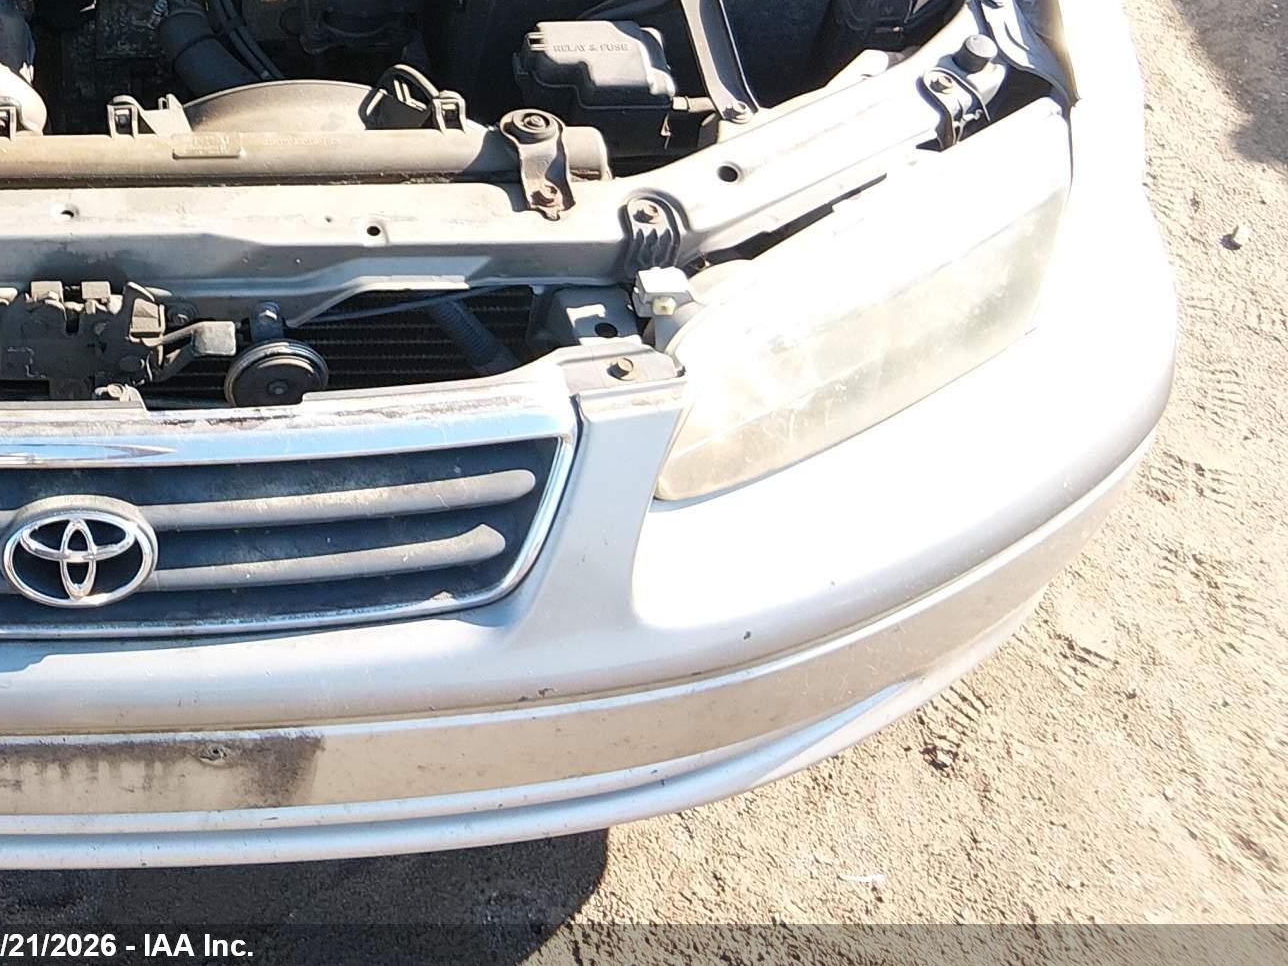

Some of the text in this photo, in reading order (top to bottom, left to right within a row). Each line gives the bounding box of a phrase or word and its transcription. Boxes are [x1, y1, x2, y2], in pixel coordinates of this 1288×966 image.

[552, 42, 629, 52] RELAY & FUSE
